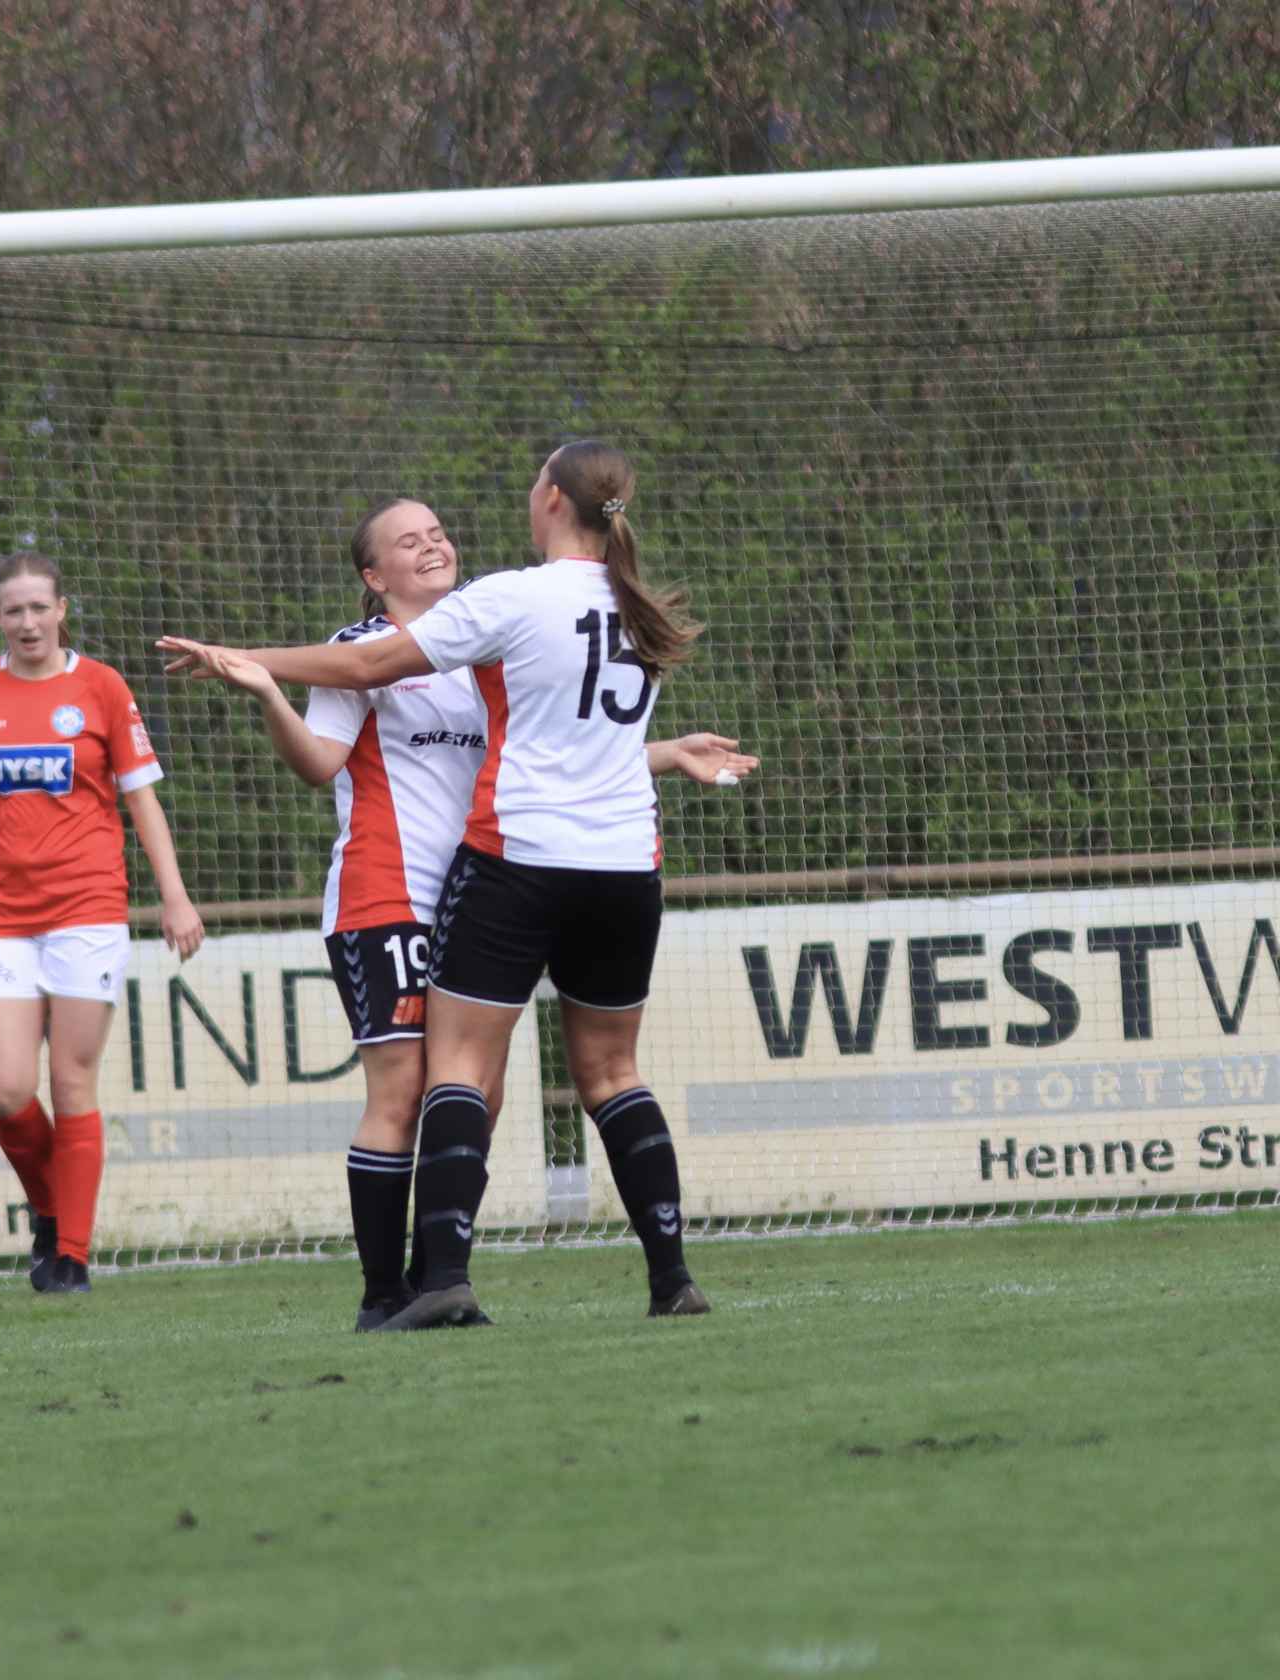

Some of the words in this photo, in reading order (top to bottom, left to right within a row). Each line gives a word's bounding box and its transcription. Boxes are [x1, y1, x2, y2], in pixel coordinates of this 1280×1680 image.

[575, 608, 652, 725] 15
[408, 730, 487, 750] SKECHE
[384, 934, 430, 990] 19
[980, 1135, 1175, 1182] Henne
